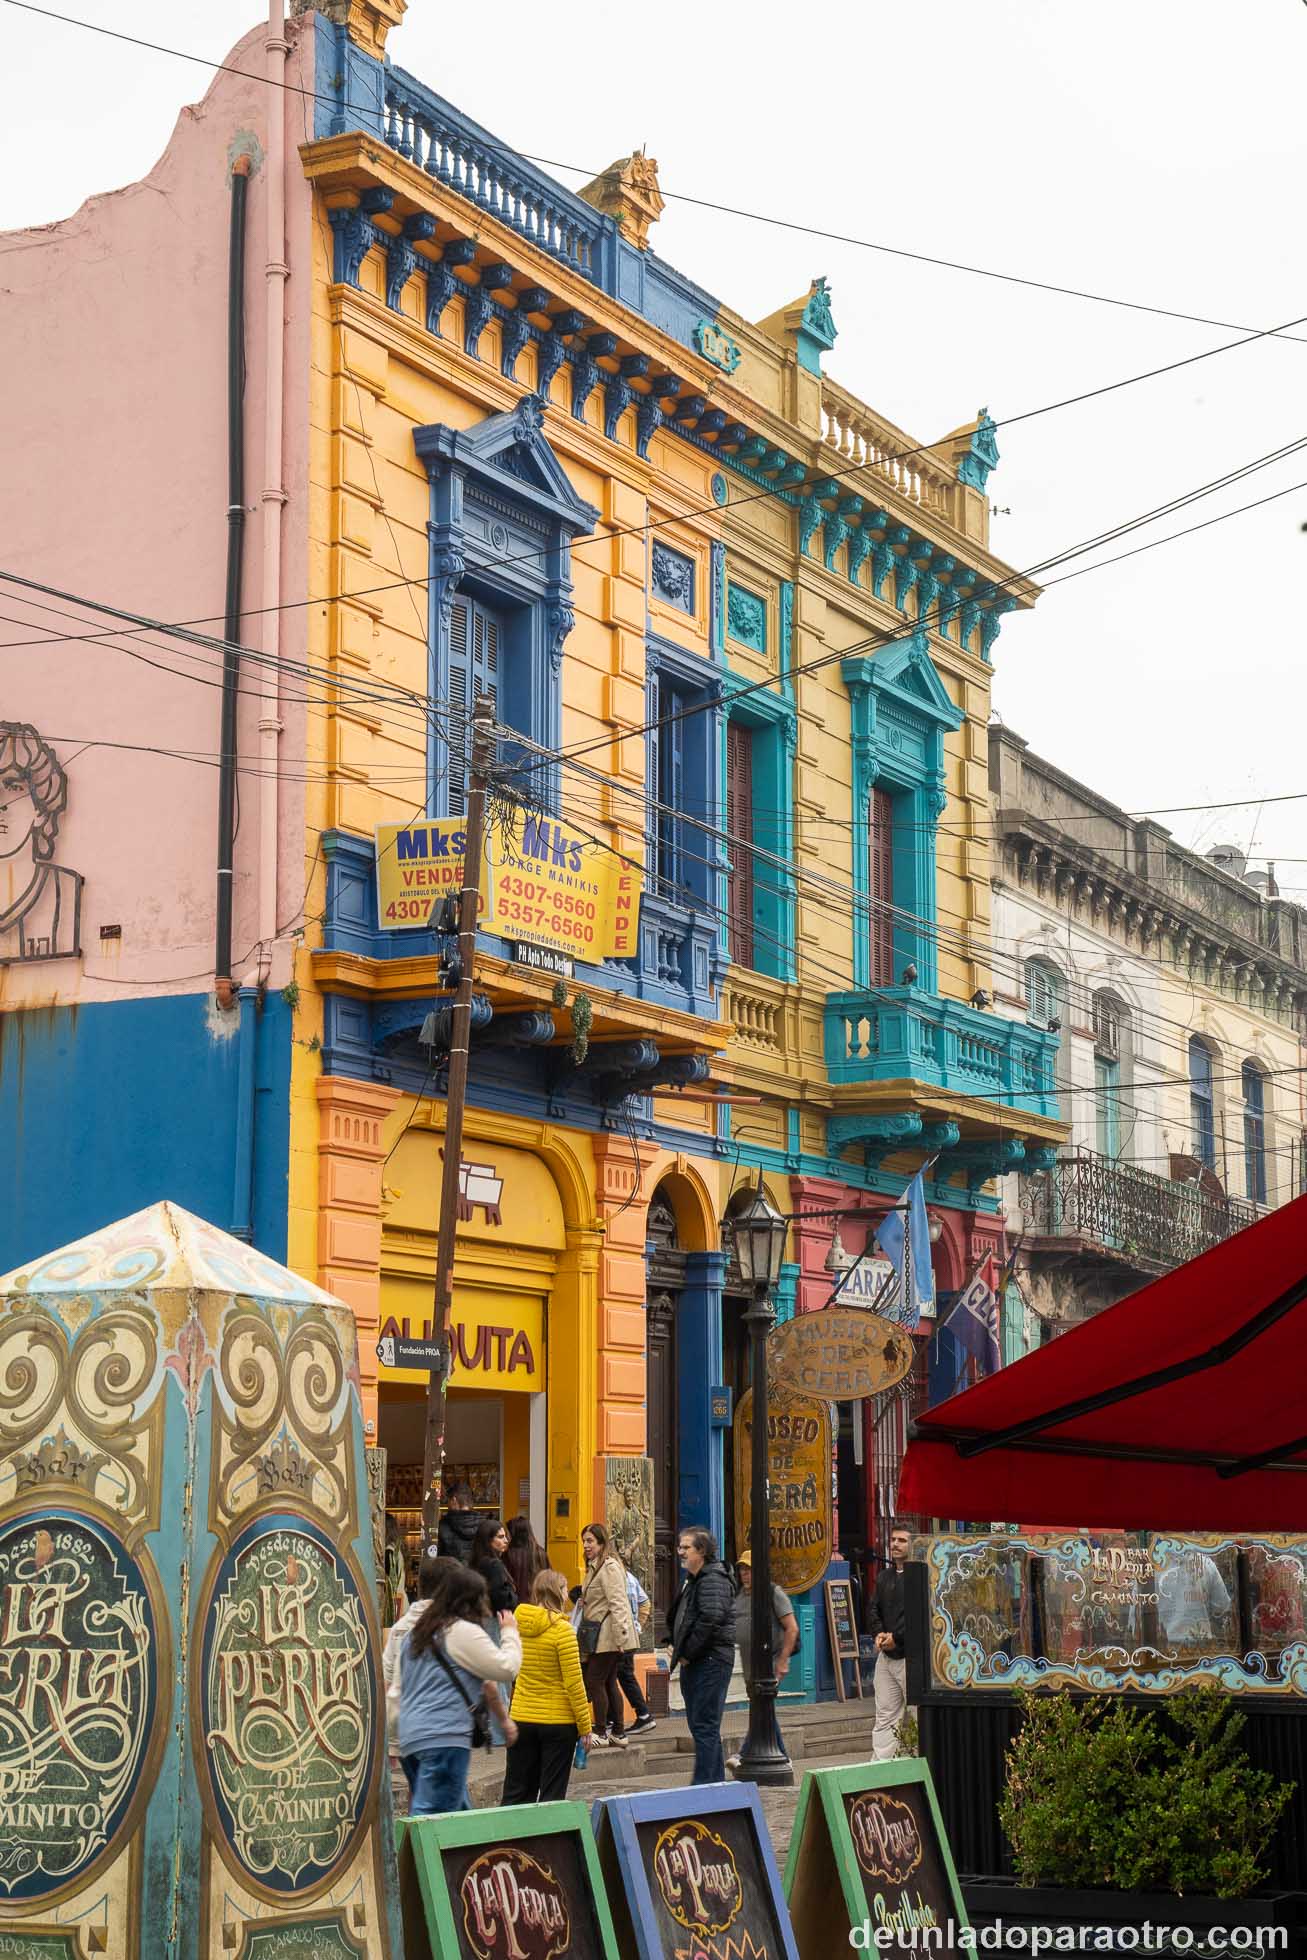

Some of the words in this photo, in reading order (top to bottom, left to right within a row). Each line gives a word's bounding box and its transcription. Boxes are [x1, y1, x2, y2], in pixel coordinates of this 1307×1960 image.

[396, 827, 466, 860] Mks
[522, 815, 583, 872] Mks
[402, 866, 465, 886] VENDE
[500, 854, 541, 875] JORGE
[549, 870, 599, 896] MANIKIS
[499, 875, 596, 920] 4307-6560
[614, 857, 635, 950] VENDE
[498, 898, 594, 943] 5357-6560
[518, 944, 527, 962] PH
[745, 1415, 820, 1443] USEO
[772, 1455, 794, 1470] DE
[55, 1533, 95, 1565] 1882
[1127, 1548, 1150, 1561] BAR
[2, 1572, 88, 1646] LA
[260, 1572, 319, 1646] LA
[208, 1647, 366, 1766] PERLA
[237, 1791, 350, 1833] CAMINITO
[658, 1849, 685, 1901] LA
[466, 1872, 497, 1944] LA
